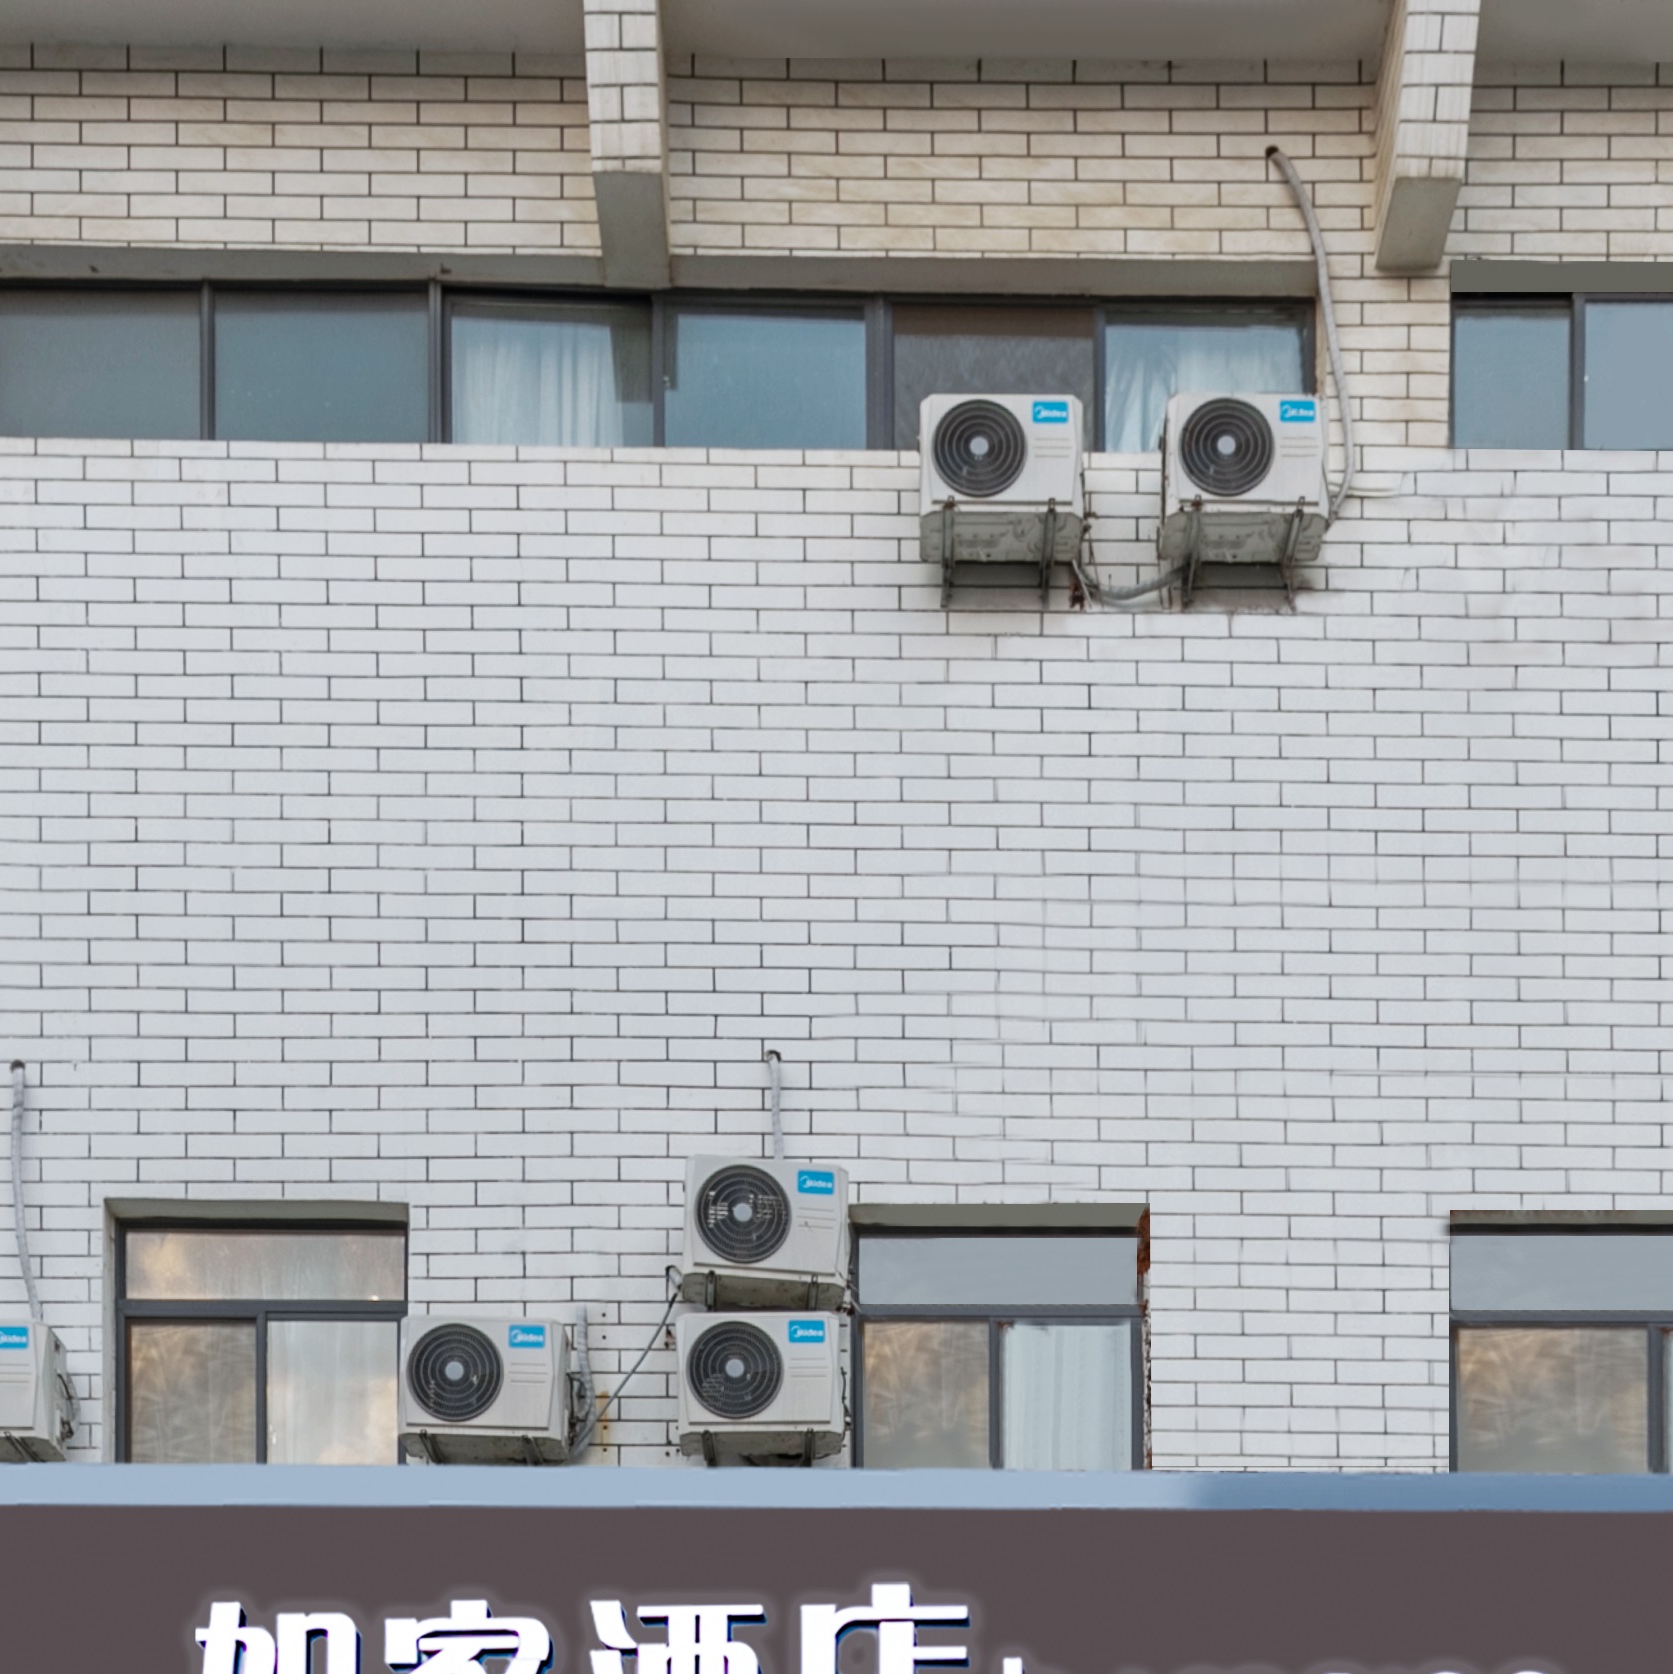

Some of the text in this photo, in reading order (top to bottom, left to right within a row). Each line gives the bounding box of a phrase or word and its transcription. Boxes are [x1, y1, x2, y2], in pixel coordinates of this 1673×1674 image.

[803, 1178, 833, 1189] Midea
[513, 1332, 544, 1343] Midea
[793, 1327, 823, 1337] Midea
